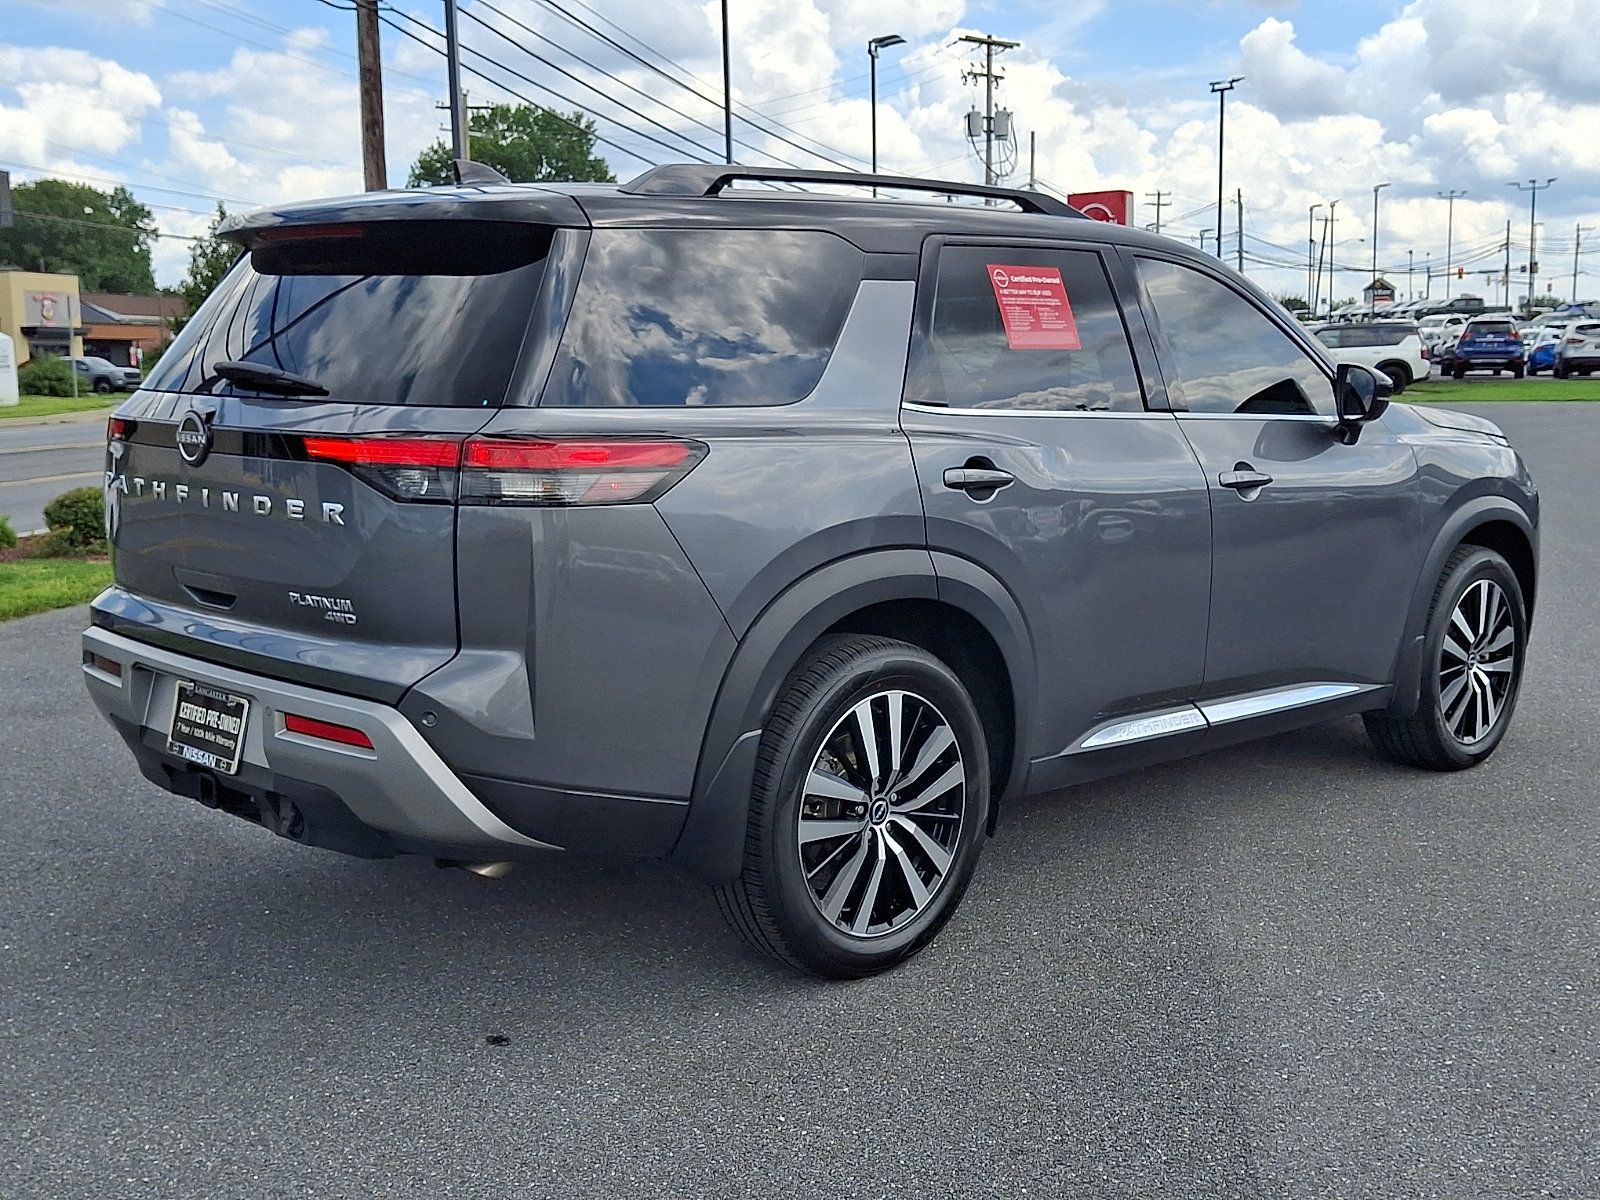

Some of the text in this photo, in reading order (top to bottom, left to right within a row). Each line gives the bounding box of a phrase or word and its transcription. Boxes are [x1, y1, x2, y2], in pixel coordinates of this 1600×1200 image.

[105, 470, 346, 526] PATHFINDER
[288, 591, 353, 612] PLATINUM
[324, 610, 358, 625] 4WD
[179, 701, 241, 735] CERTIFIED PRE-OWNED
[1118, 712, 1200, 738] PATHFINDER
[182, 747, 216, 768] NISSAN
